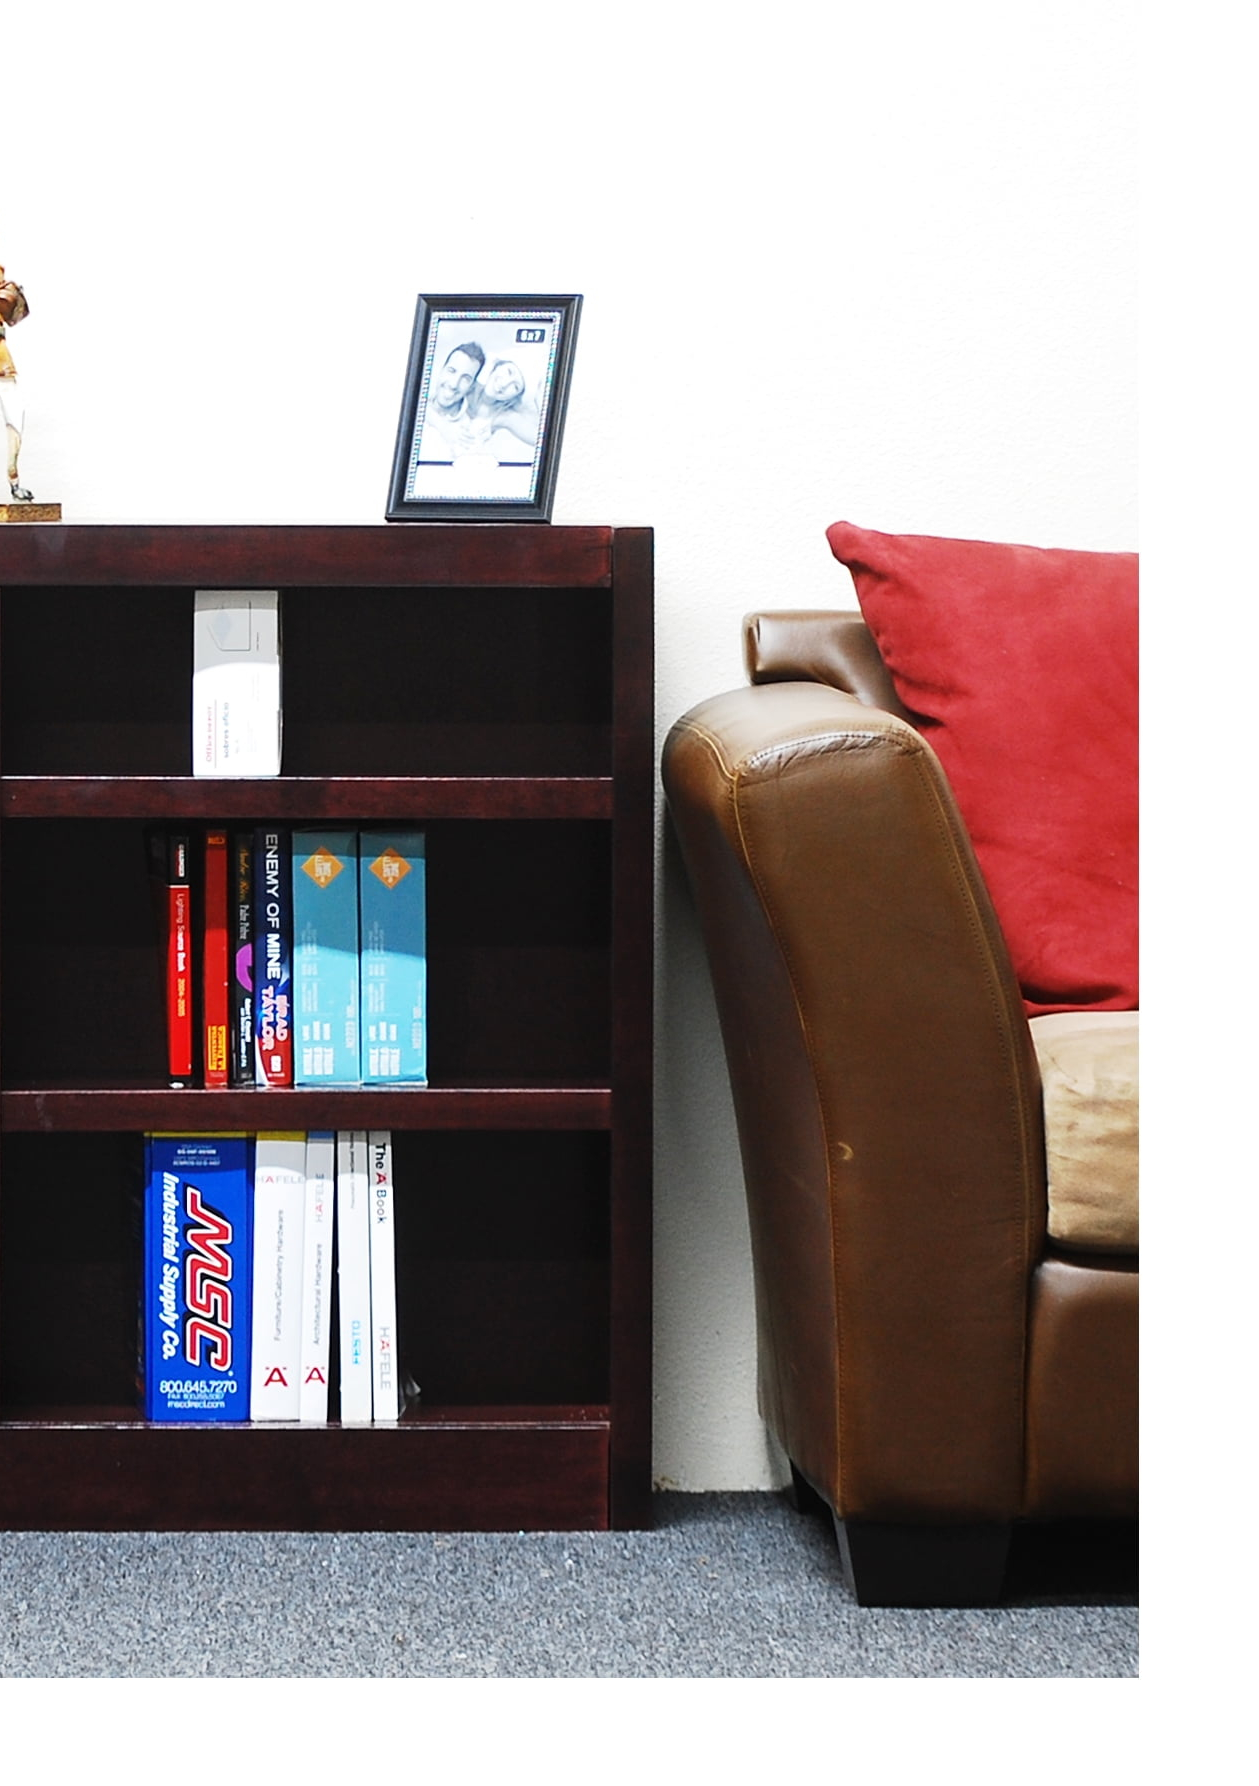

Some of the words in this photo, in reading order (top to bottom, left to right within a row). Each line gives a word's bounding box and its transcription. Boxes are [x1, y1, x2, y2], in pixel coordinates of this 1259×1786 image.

[265, 834, 279, 898] ENEMY
[175, 893, 186, 923] Lighting
[266, 903, 280, 928] OF
[266, 933, 281, 980] MINE
[261, 985, 277, 1050] TAYLOR
[277, 995, 288, 1041] BRAD
[375, 1143, 386, 1169] The
[162, 1173, 179, 1261] Industrial
[376, 1189, 387, 1224] Book
[184, 1186, 234, 1371] MSC
[314, 1243, 322, 1286] Hardware
[159, 1263, 179, 1327] Supply
[313, 1289, 322, 1345] Architectural
[162, 1330, 179, 1360] Co.
[160, 1380, 237, 1393] 800.645.7270
